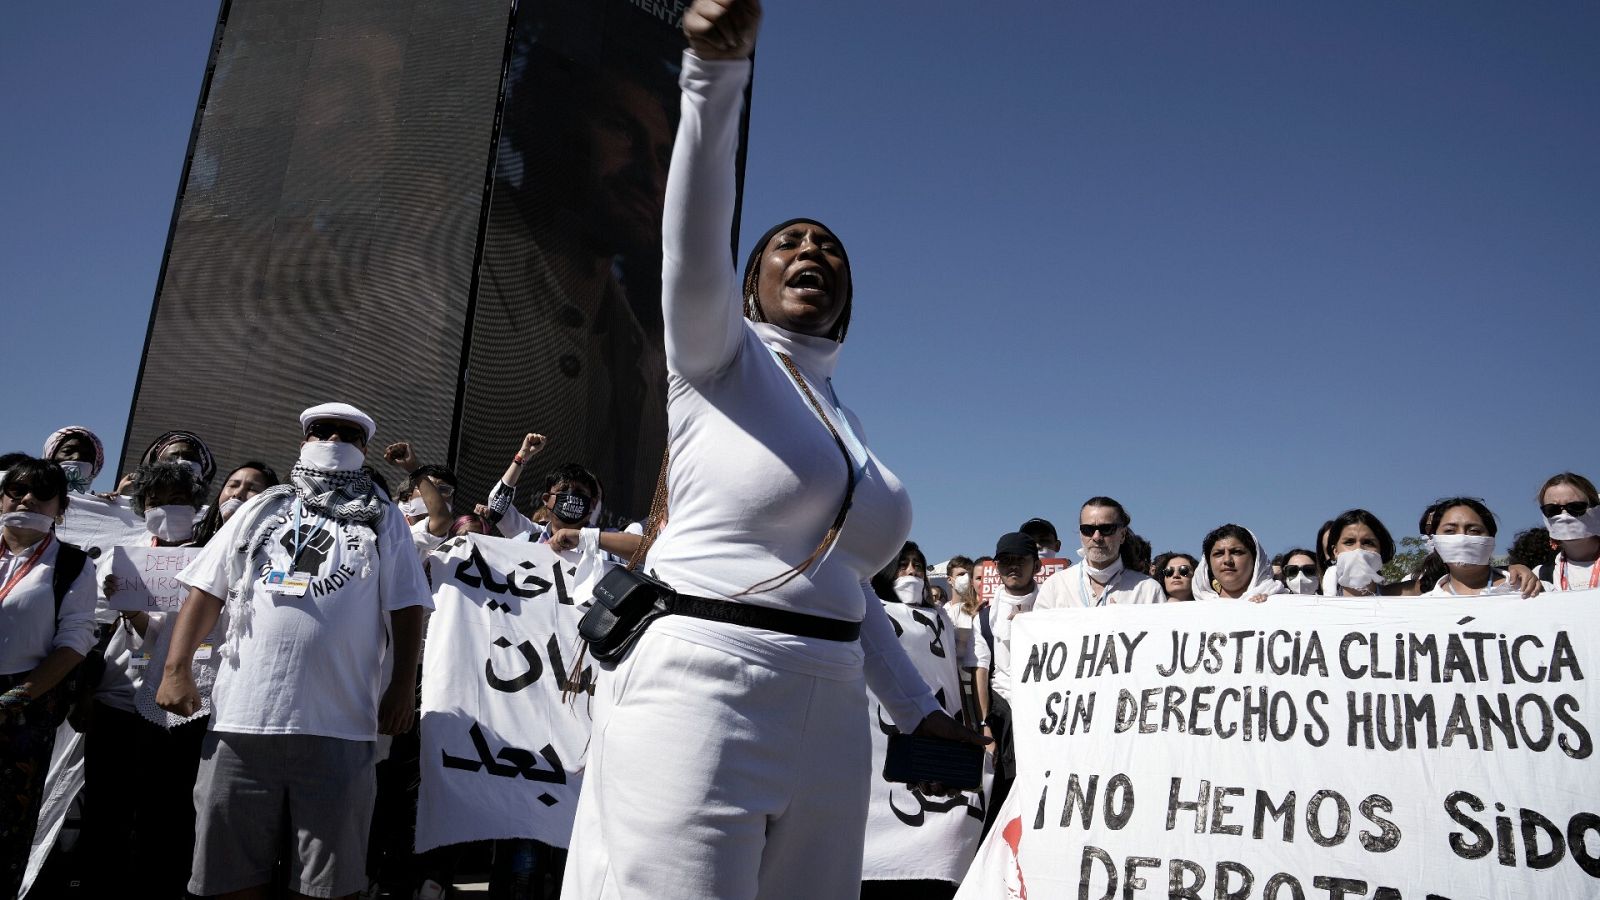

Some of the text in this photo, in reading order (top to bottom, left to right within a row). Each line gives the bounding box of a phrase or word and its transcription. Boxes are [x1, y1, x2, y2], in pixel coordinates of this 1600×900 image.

[117, 576, 182, 591] ENVIRO
[312, 563, 355, 598] NADIE
[1021, 641, 1068, 683] NO
[1075, 630, 1149, 679] HAY
[1039, 685, 1594, 760] SiN DERECHOS HUMANOS
[1165, 776, 1401, 853] HEMOS
